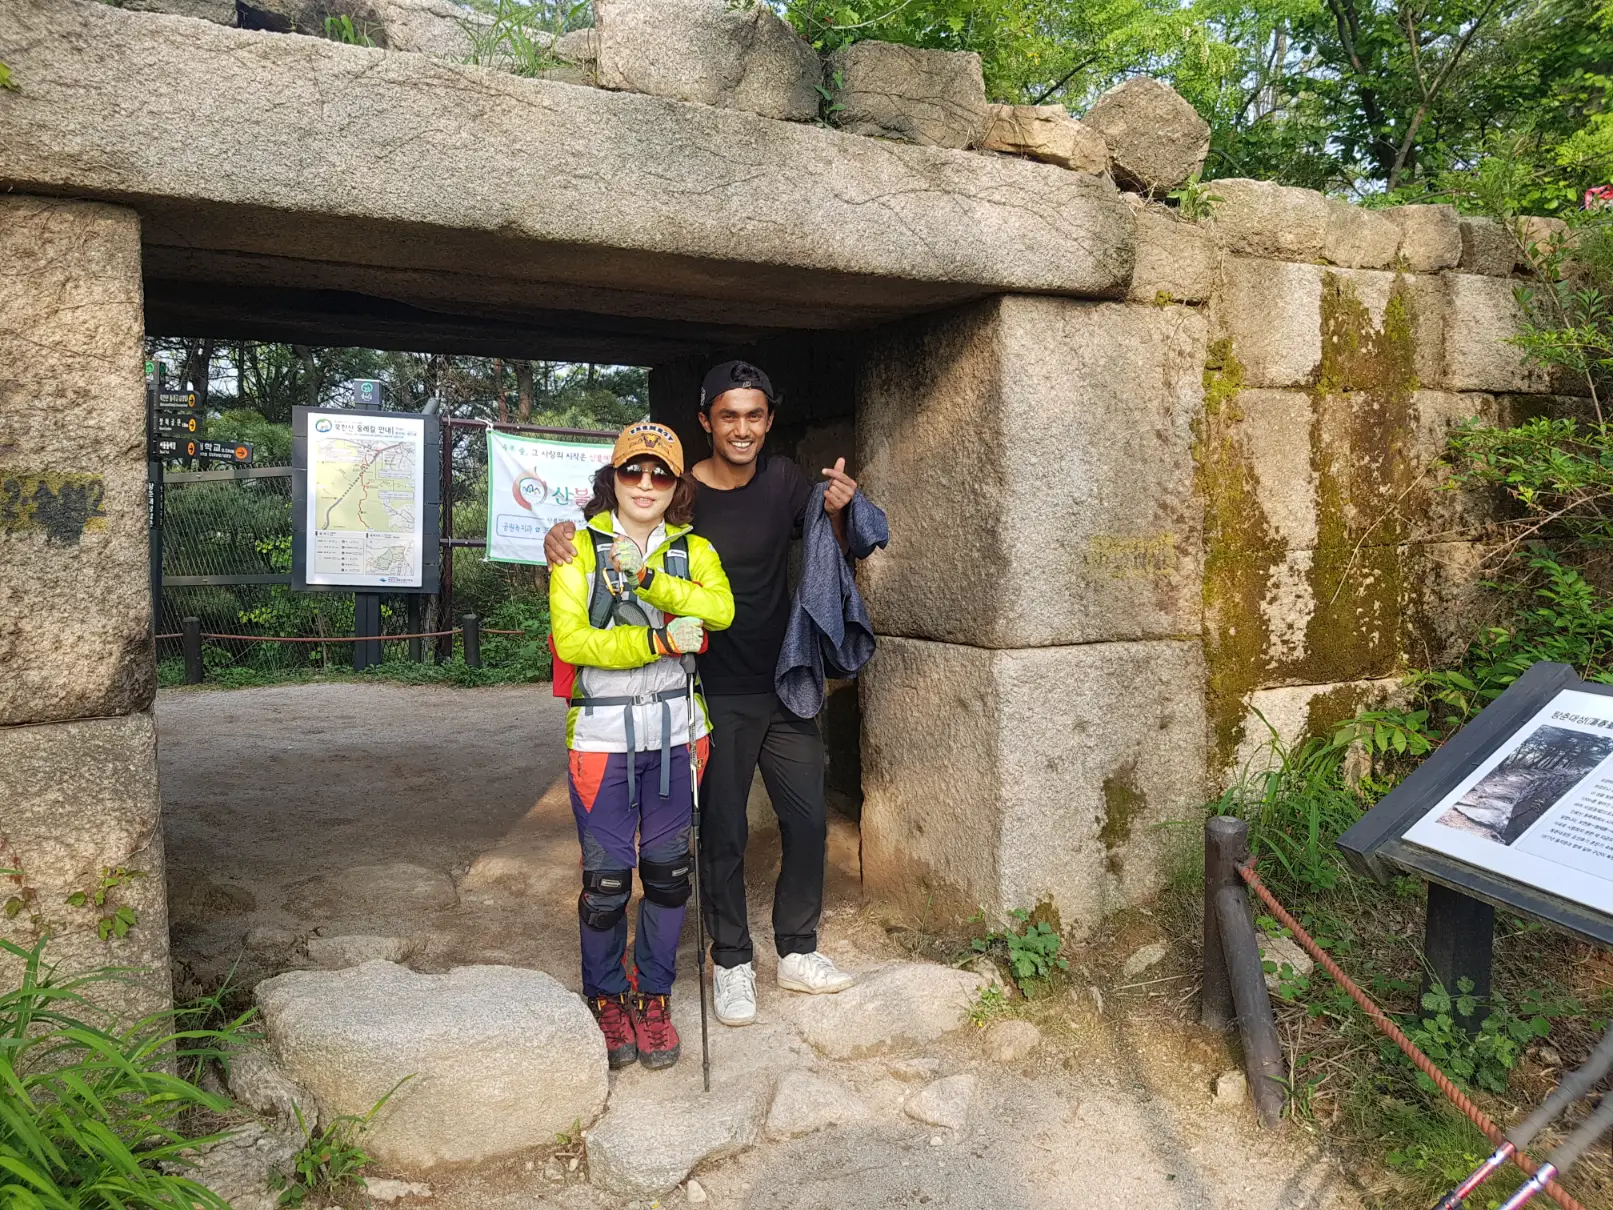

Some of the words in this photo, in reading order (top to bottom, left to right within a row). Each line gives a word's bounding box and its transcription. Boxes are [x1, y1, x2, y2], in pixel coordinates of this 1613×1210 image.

[356, 425, 376, 433] 둘레길
[378, 426, 392, 434] 안내
[541, 450, 564, 460] 사랑의
[565, 452, 587, 462] 시작은
